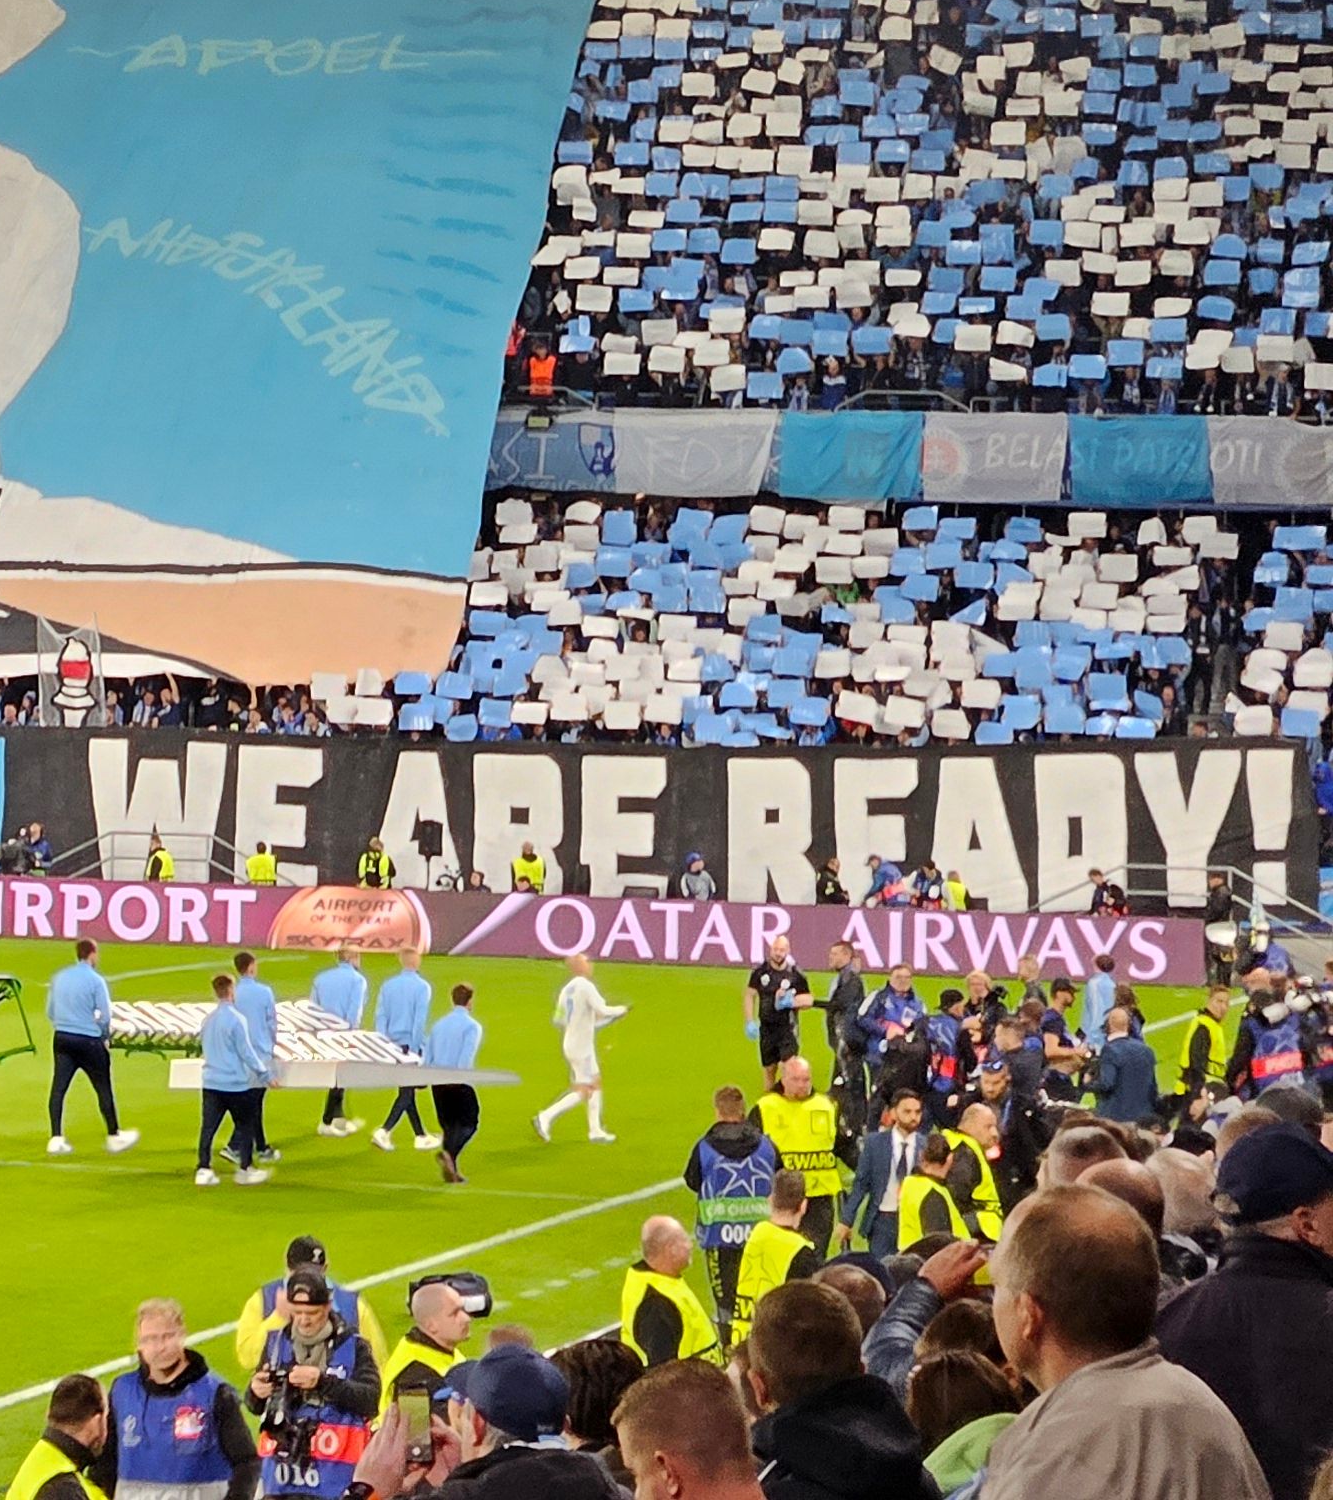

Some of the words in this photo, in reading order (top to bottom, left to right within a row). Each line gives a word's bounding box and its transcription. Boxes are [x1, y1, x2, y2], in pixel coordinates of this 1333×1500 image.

[122, 32, 429, 77] APOEL
[87, 738, 323, 888] WE
[375, 751, 668, 900] ARE
[727, 748, 1295, 914] READY!
[310, 914, 323, 923] OF
[332, 914, 352, 924] THE
[359, 915, 392, 925] YEAR
[313, 898, 398, 913] AIRPORT
[535, 896, 793, 961] QATAR
[275, 1464, 319, 1487] 016
